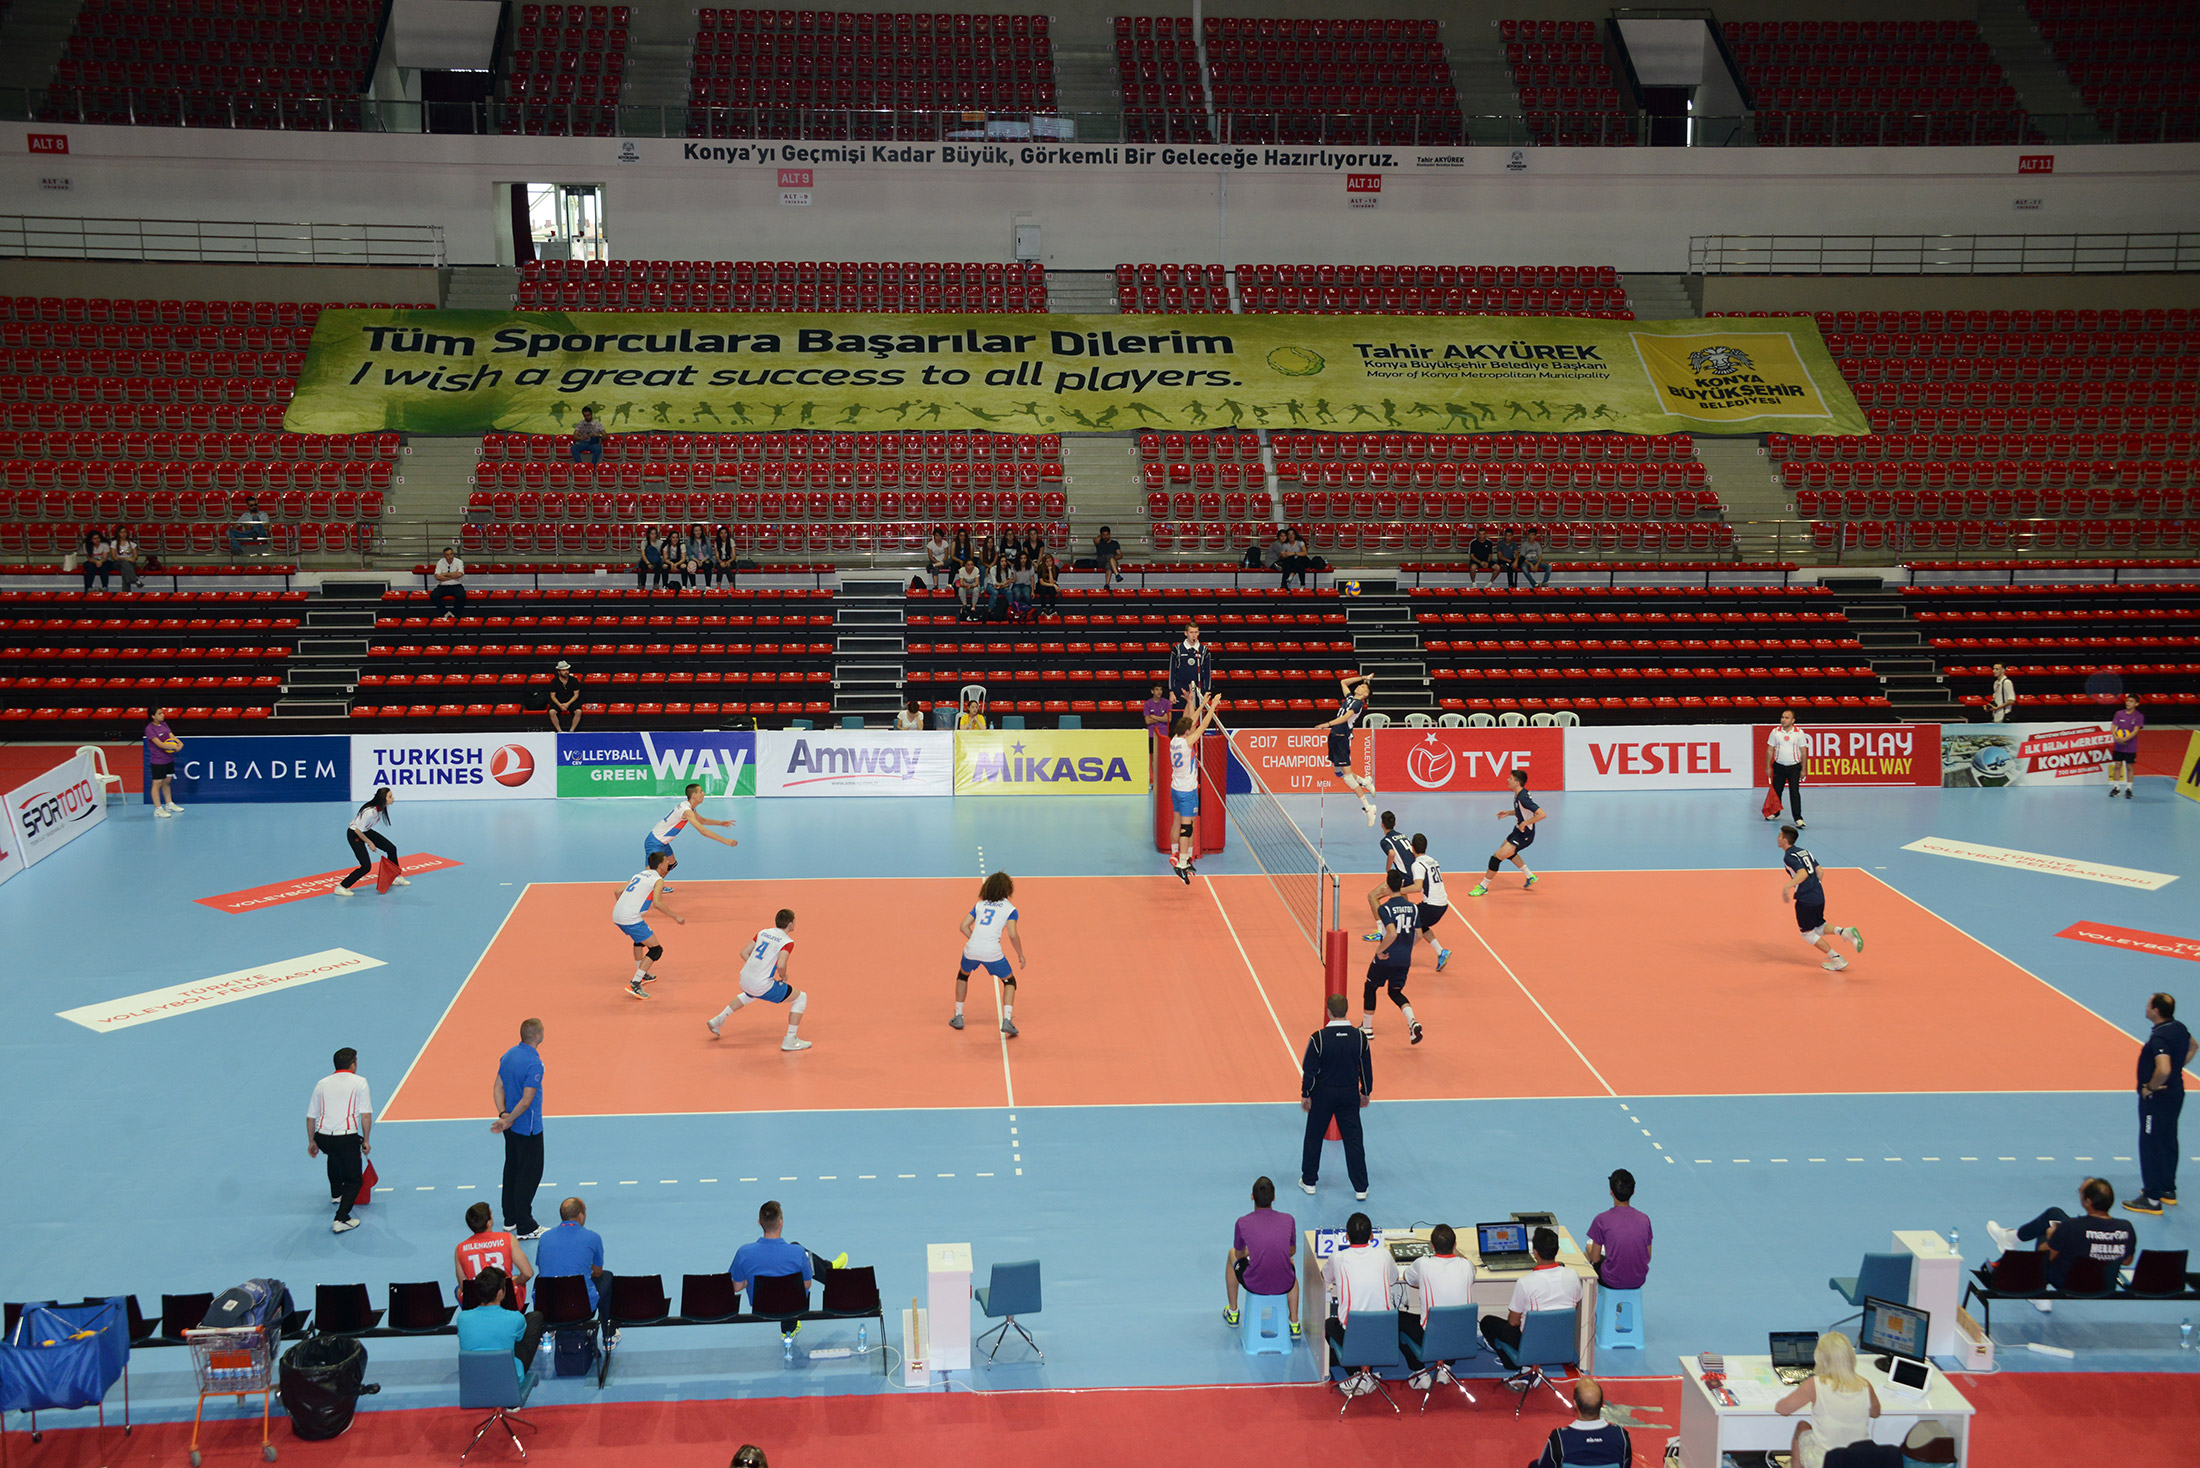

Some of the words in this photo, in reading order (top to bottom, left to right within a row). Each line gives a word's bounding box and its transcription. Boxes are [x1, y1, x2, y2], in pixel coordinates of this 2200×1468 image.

[33, 138, 53, 150] ALT
[56, 139, 65, 150] 8
[782, 145, 866, 165] Geçmişi
[873, 146, 936, 162] Kadar
[942, 146, 1014, 166] Büyük,
[1021, 147, 1118, 165] Görkemli
[1125, 149, 1156, 165] Bir
[1162, 149, 1257, 169] Geleceğe
[1264, 149, 1398, 169] Hazırlıyoruz.
[2019, 159, 2037, 170] ALT
[2039, 159, 2051, 169] 11
[781, 173, 800, 184] ALT
[802, 173, 809, 184] 9
[1348, 178, 1366, 189] ALT
[1367, 178, 1380, 189] 10
[361, 325, 475, 357] Tüm
[492, 328, 780, 357] Sporculara
[798, 329, 1036, 358] Başarılar
[1049, 330, 1234, 357] Dilerim
[1352, 343, 1434, 360] Tahir
[1443, 341, 1603, 361] AKYÜREK
[1363, 359, 1407, 370] Konya
[1410, 359, 1488, 370] Büyükşehir
[1490, 360, 1550, 372] Belediye
[1552, 361, 1607, 372] Başkanı
[348, 360, 373, 386] I
[383, 363, 503, 393] wish
[513, 367, 551, 386] a
[556, 365, 699, 393] great
[707, 365, 906, 387] success
[921, 363, 971, 387] to
[984, 362, 1044, 386] all
[1054, 365, 1242, 394] players.
[1366, 371, 1404, 380] Mayor
[1421, 371, 1459, 380] Konya
[1461, 371, 1536, 381] Metropolitan
[1539, 371, 1610, 382] Municipality
[1694, 374, 1765, 388] KONYA
[1667, 383, 1805, 401] BÜYÜKŞEHİR
[1699, 396, 1781, 409] BELEDİYESİ
[1250, 736, 1278, 748] 2017
[1287, 735, 1328, 748] EUROP
[1804, 733, 1841, 757] AIR
[1849, 733, 1912, 757] PLAY
[2025, 744, 2041, 755] İLK
[2042, 741, 2067, 752] BİLİM
[373, 748, 483, 765] TURKISH
[640, 731, 749, 797] WAY
[786, 739, 922, 780] Amway
[1262, 755, 1332, 768] CHAMPIONS
[1462, 750, 1532, 777] TVF
[1588, 742, 1732, 775] VESTEL
[168, 760, 337, 780] CIBADEM
[590, 769, 648, 781] GREEN
[1807, 758, 1878, 776] LLEYBALL
[1880, 758, 1913, 776] WAY
[372, 768, 484, 785] AIRLINES
[1922, 844, 2007, 862] VOLEYBOL
[2015, 860, 2152, 885] FEDERASYONU
[2003, 853, 2078, 868] TÜRKİYE
[291, 873, 350, 889] TÜRKİ
[626, 877, 641, 892] 2
[228, 886, 323, 909] VOLEYBOL
[980, 908, 995, 926] 3
[1395, 914, 1412, 934] 14
[755, 941, 770, 960] 4
[2077, 930, 2186, 954] VOLEYBOL
[98, 996, 215, 1024] VOLEYBOL
[218, 959, 362, 998] FEDERASYONU
[178, 974, 270, 997] TÜRKİYE
[2086, 1230, 2129, 1241] macron
[462, 1239, 505, 1253] MILENKOVIĆ
[1324, 1239, 1333, 1253] 2
[2090, 1243, 2126, 1254] HELLAS
[468, 1251, 506, 1280] 13
